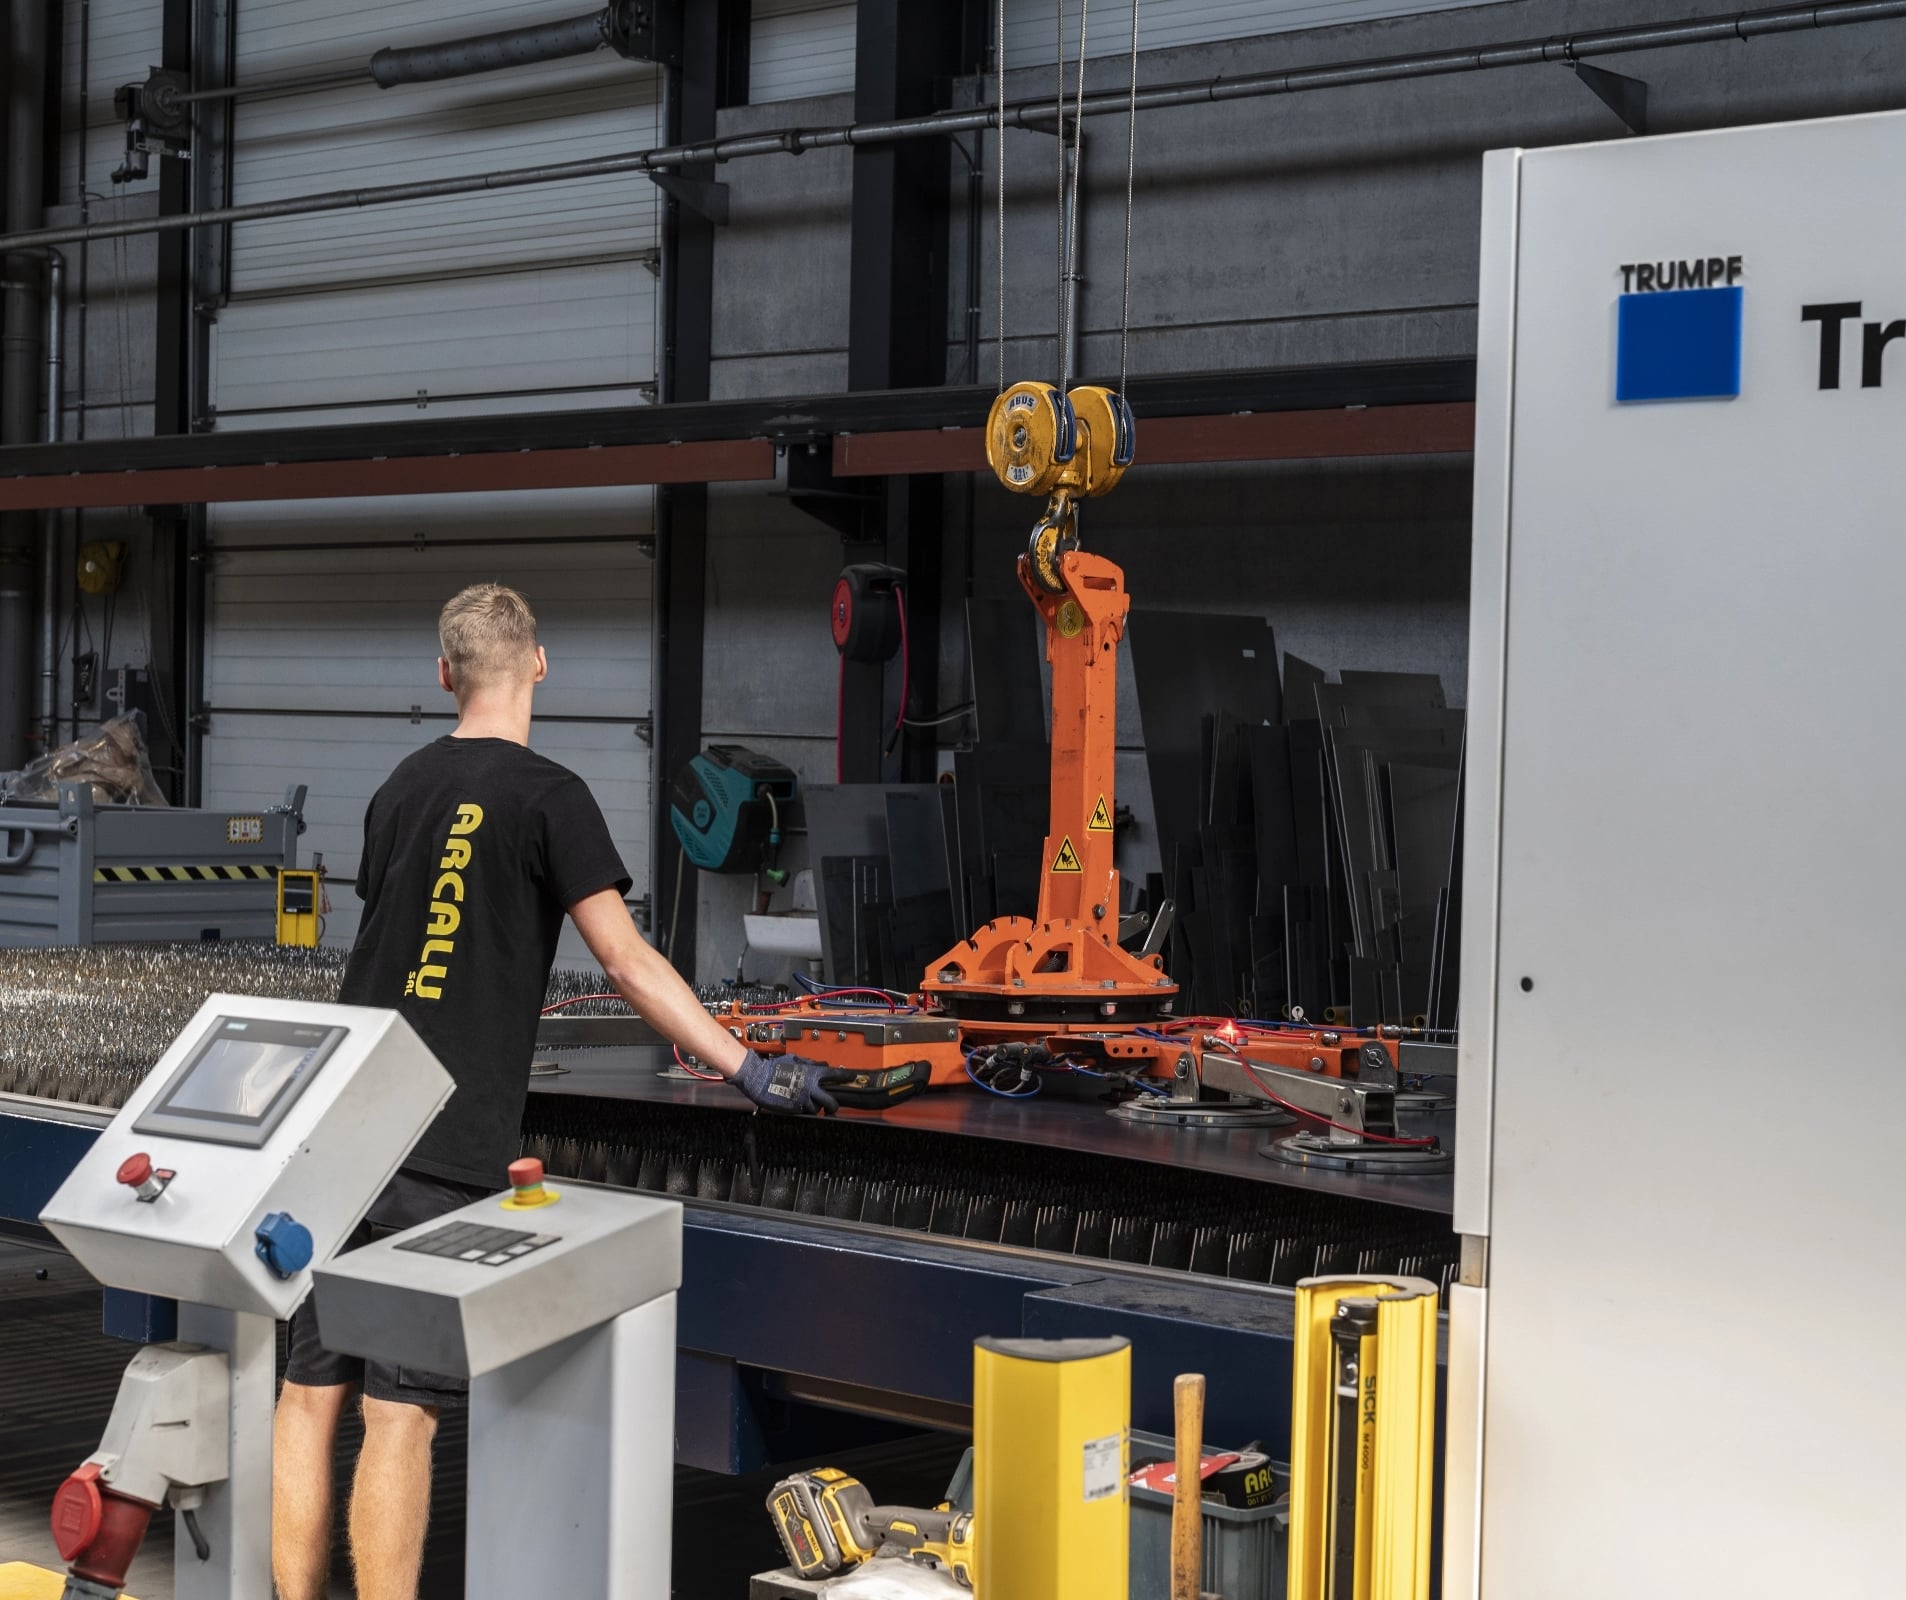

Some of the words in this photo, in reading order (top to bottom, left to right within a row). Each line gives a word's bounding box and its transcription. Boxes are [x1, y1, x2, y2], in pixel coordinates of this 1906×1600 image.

[1620, 256, 1743, 293] TRUMPF
[1802, 301, 1906, 390] Tr
[1009, 395, 1034, 411] ABUS
[415, 803, 484, 1000] ARCALU
[404, 970, 416, 997] SRL
[1364, 1376, 1376, 1425] SICK
[1361, 1444, 1369, 1470] 4000
